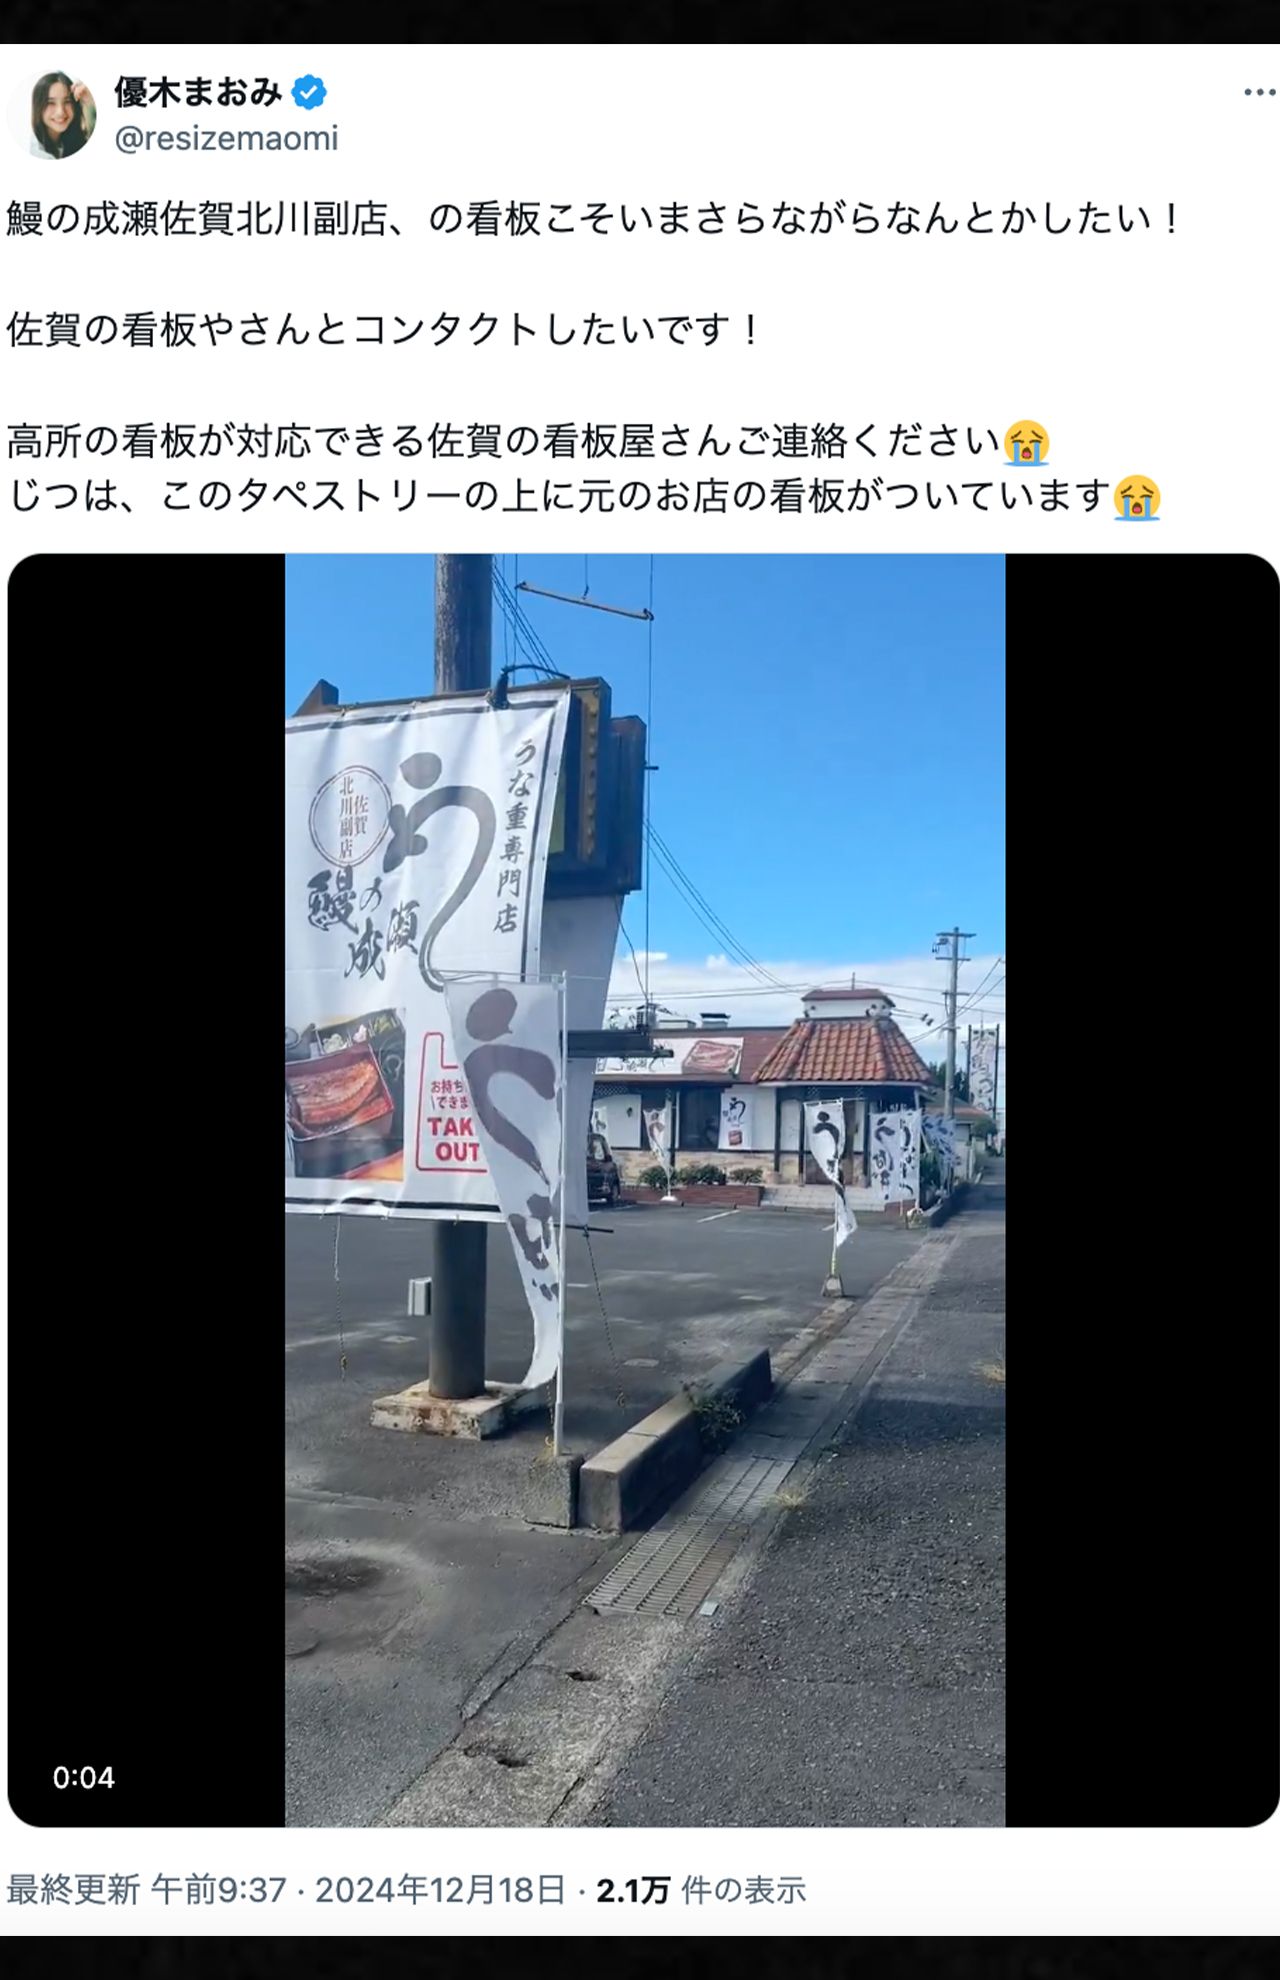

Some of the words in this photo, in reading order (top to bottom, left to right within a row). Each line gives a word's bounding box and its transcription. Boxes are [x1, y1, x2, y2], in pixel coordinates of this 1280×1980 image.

[339, 776, 353, 860] 北川副店
[354, 795, 368, 836] 佐賀
[493, 738, 537, 934] うな重専門店
[430, 1079, 468, 1094] お持ち
[436, 1096, 468, 1110] できま
[427, 1117, 473, 1136] TAK
[435, 1142, 480, 1162] OUT
